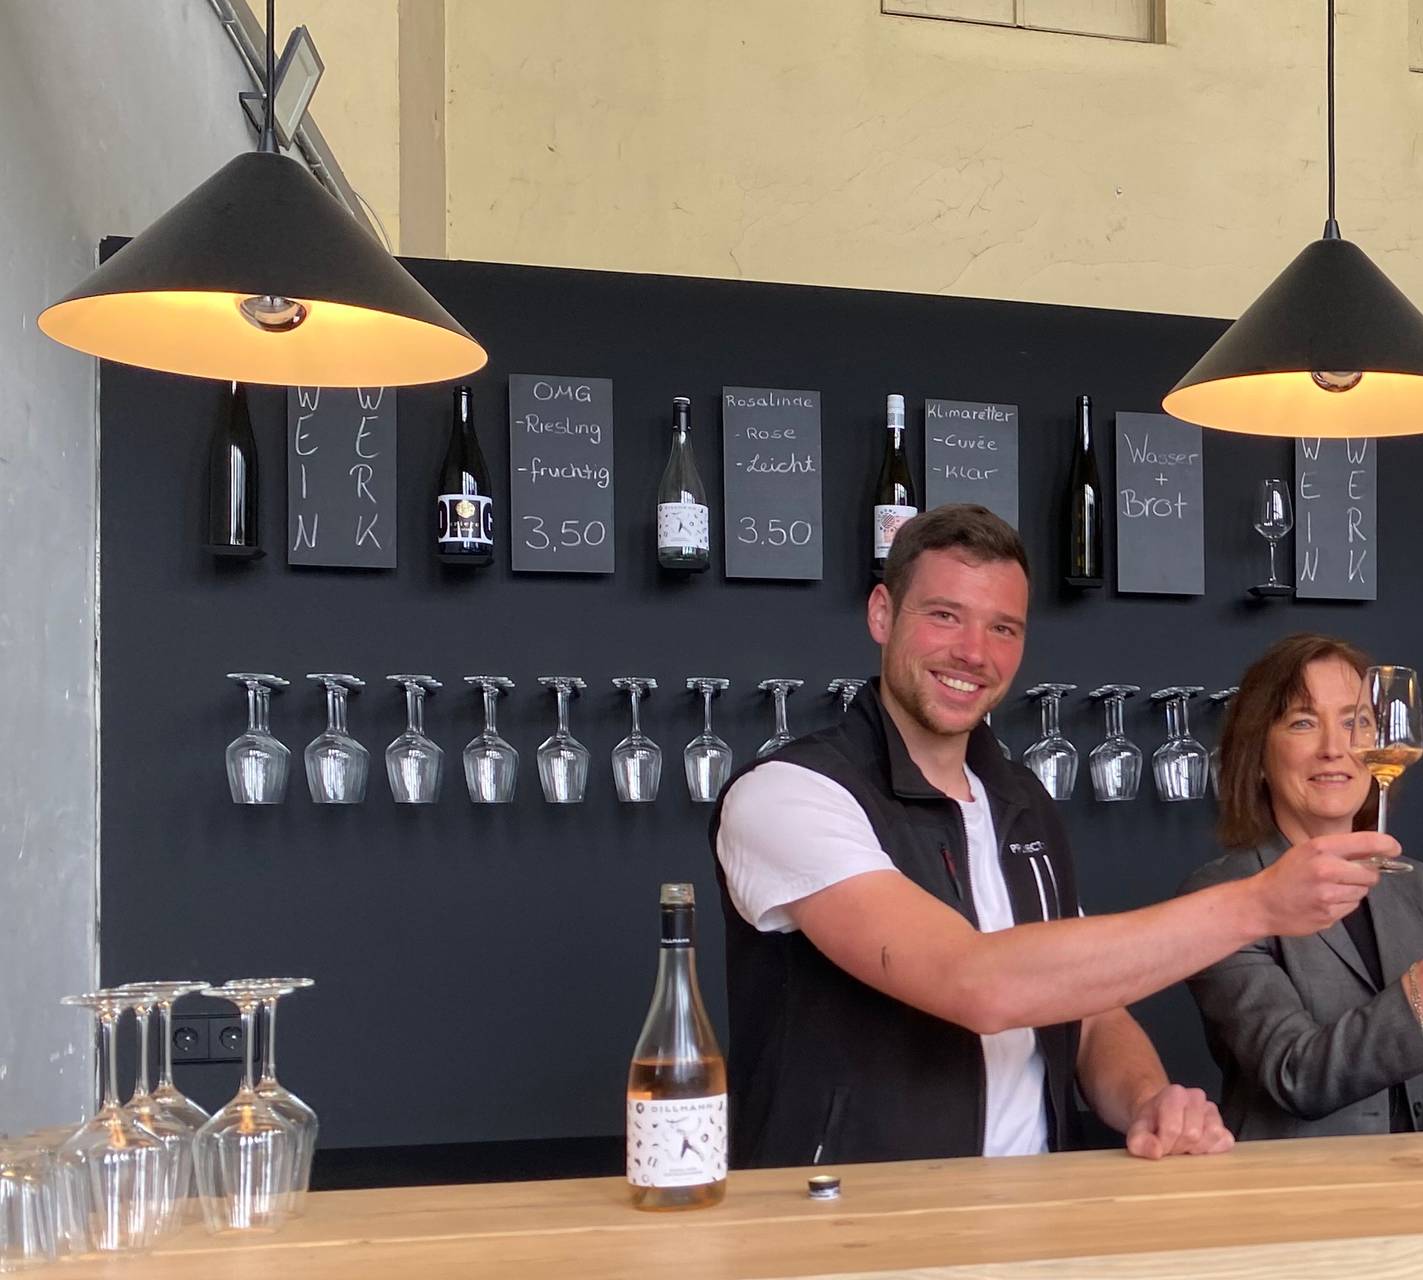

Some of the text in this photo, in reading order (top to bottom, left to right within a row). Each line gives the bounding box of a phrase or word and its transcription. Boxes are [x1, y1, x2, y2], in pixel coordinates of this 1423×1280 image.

[533, 381, 592, 402] OMG
[1123, 433, 1200, 466] Wasser
[1120, 488, 1188, 519] Brot
[522, 515, 606, 553] 3,50
